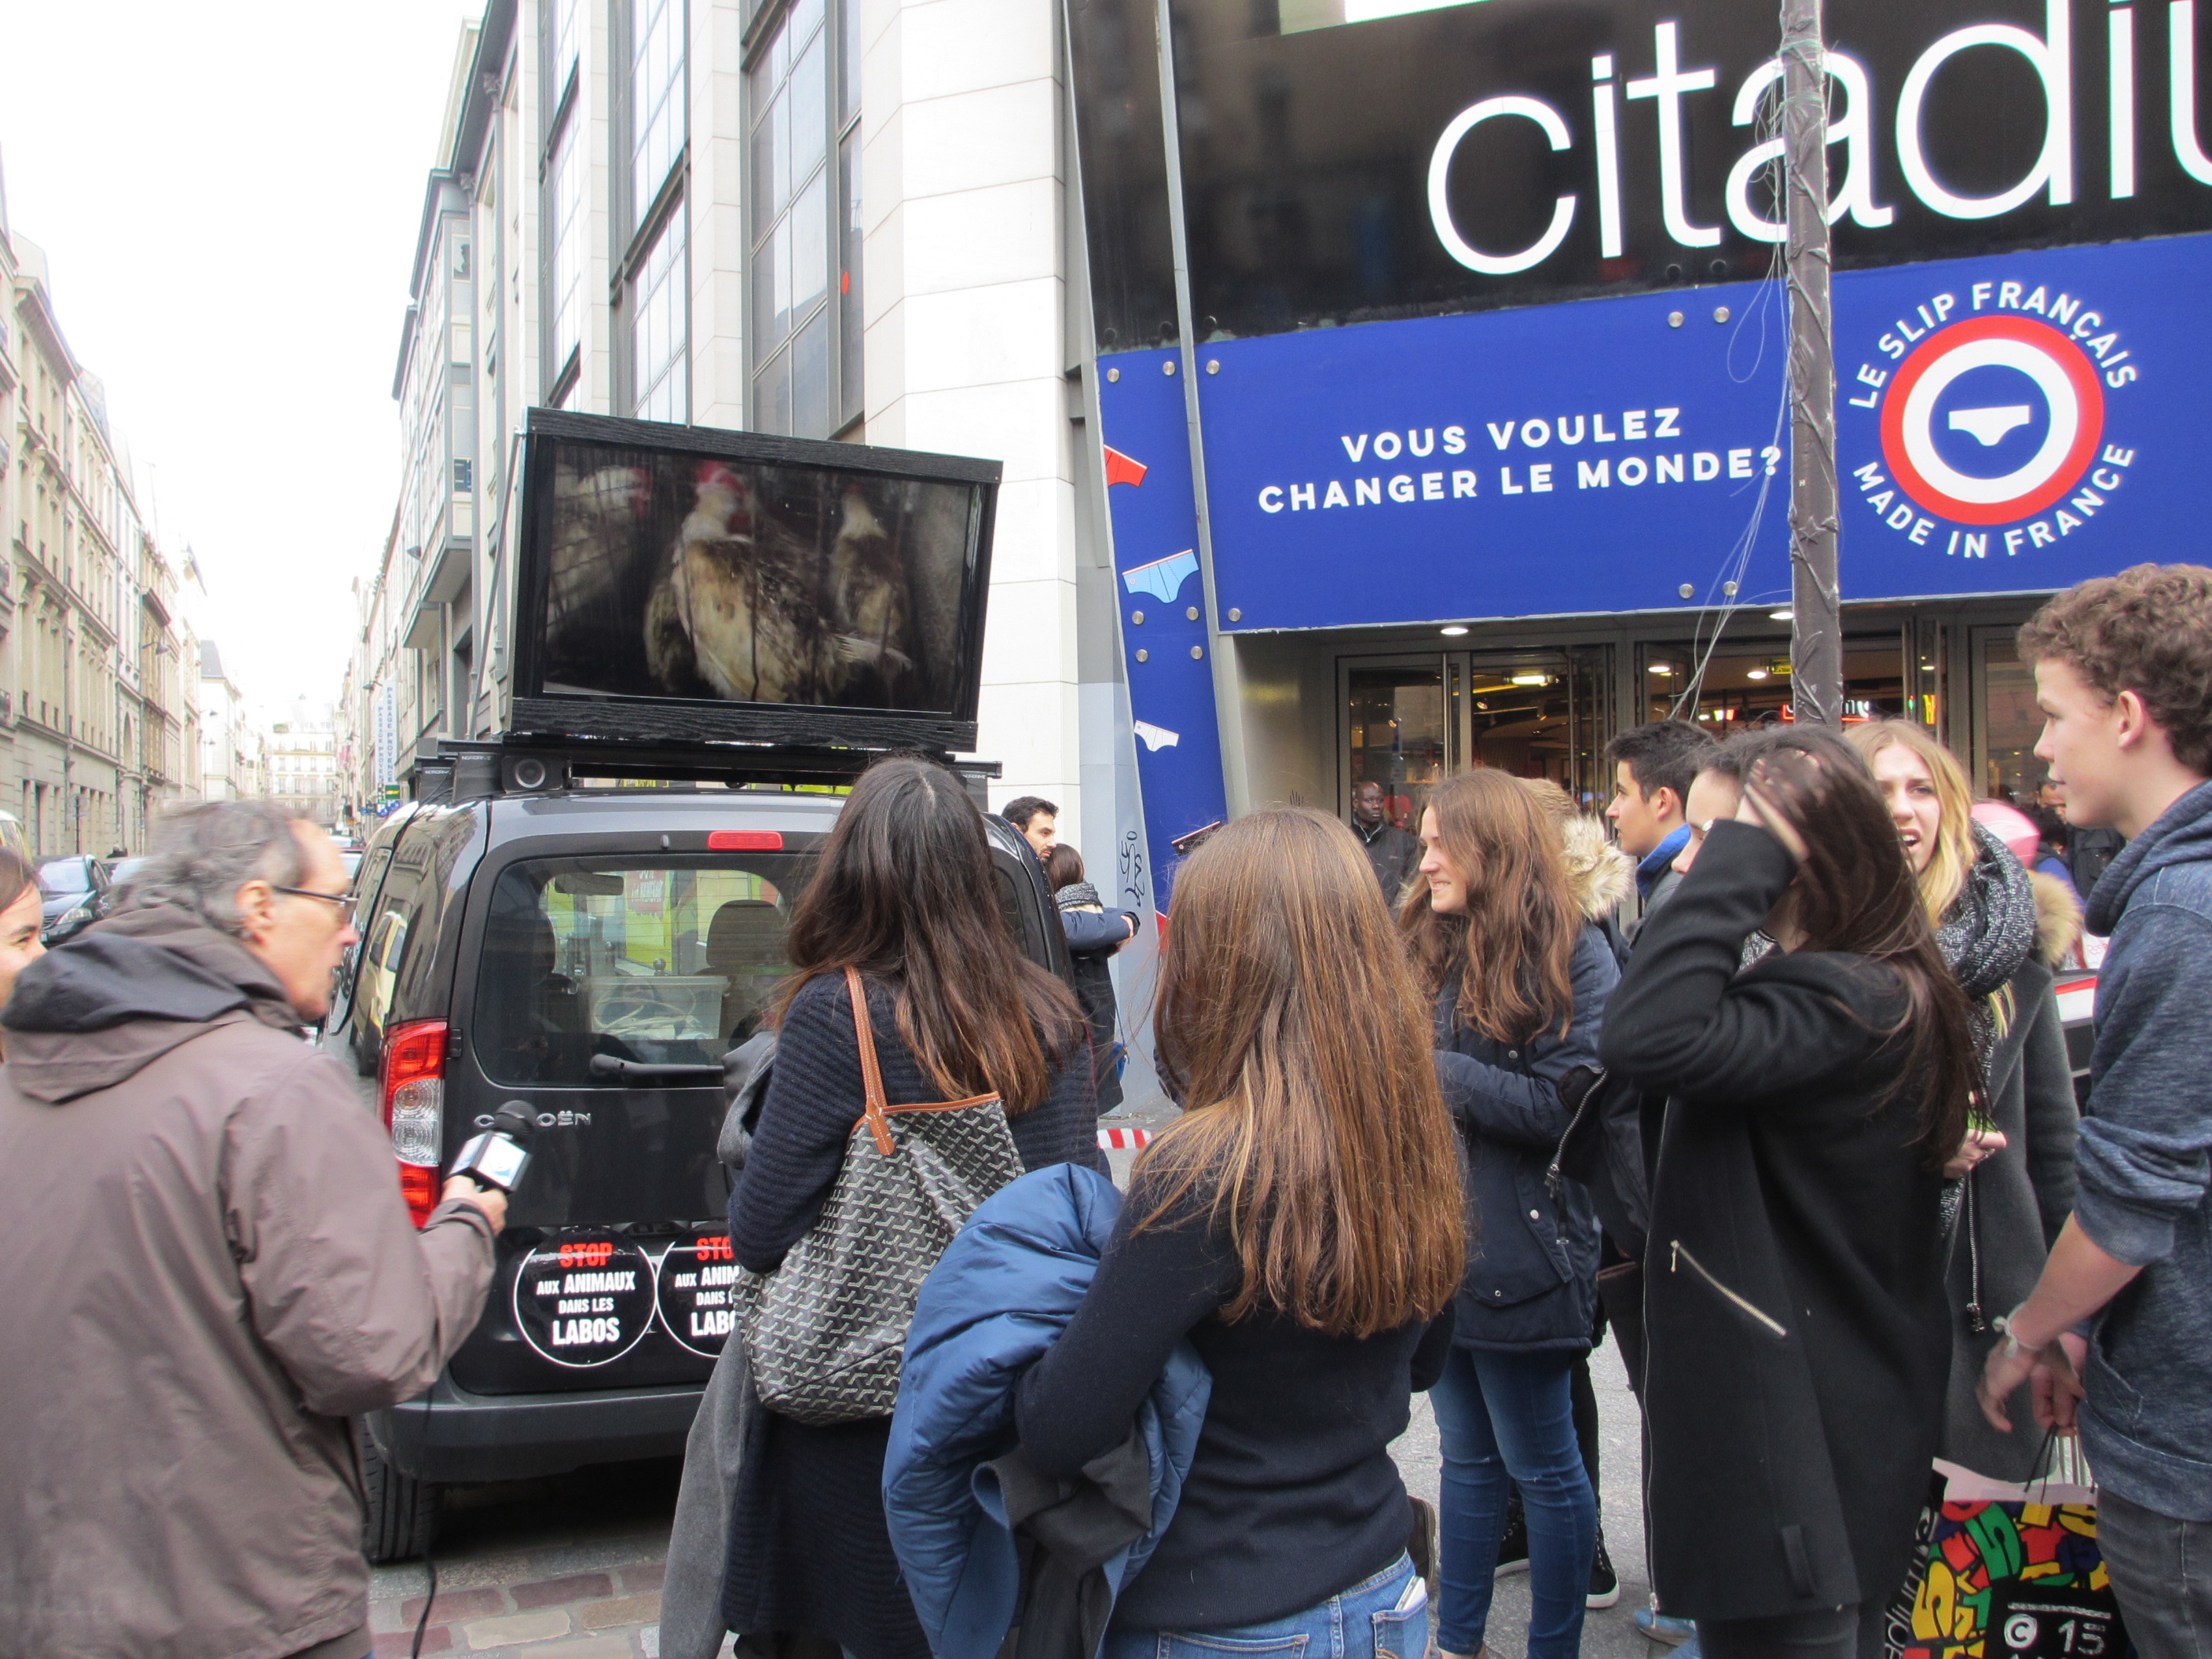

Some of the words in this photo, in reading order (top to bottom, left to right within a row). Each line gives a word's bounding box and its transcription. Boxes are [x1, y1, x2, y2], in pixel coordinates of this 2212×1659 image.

[1849, 363, 1888, 408] LE
[1879, 293, 1955, 359] SLIP
[1972, 280, 2137, 388] FRANÇAIS
[1341, 425, 1467, 463] VOUS
[1486, 407, 1681, 450] VOULEZ
[1258, 470, 1478, 513] CHANGER
[1500, 463, 1554, 495] LE
[1577, 445, 1782, 489] MONDE?
[1853, 461, 1936, 546] MADE
[1947, 530, 1987, 558] IN
[2004, 444, 2135, 556] FRANCE
[474, 1110, 591, 1127] COËN
[560, 1242, 613, 1268] STOP
[696, 1236, 734, 1261] STO
[536, 1280, 560, 1295] AUX
[563, 1270, 635, 1295] ANIMAUX
[674, 1273, 697, 1287] AUX
[701, 1265, 740, 1287] ANIM
[558, 1298, 590, 1314] DANS
[591, 1297, 614, 1312] LES
[696, 1291, 726, 1306] DANS
[552, 1317, 620, 1346] LABOS
[2058, 1618, 2106, 1655] 15
